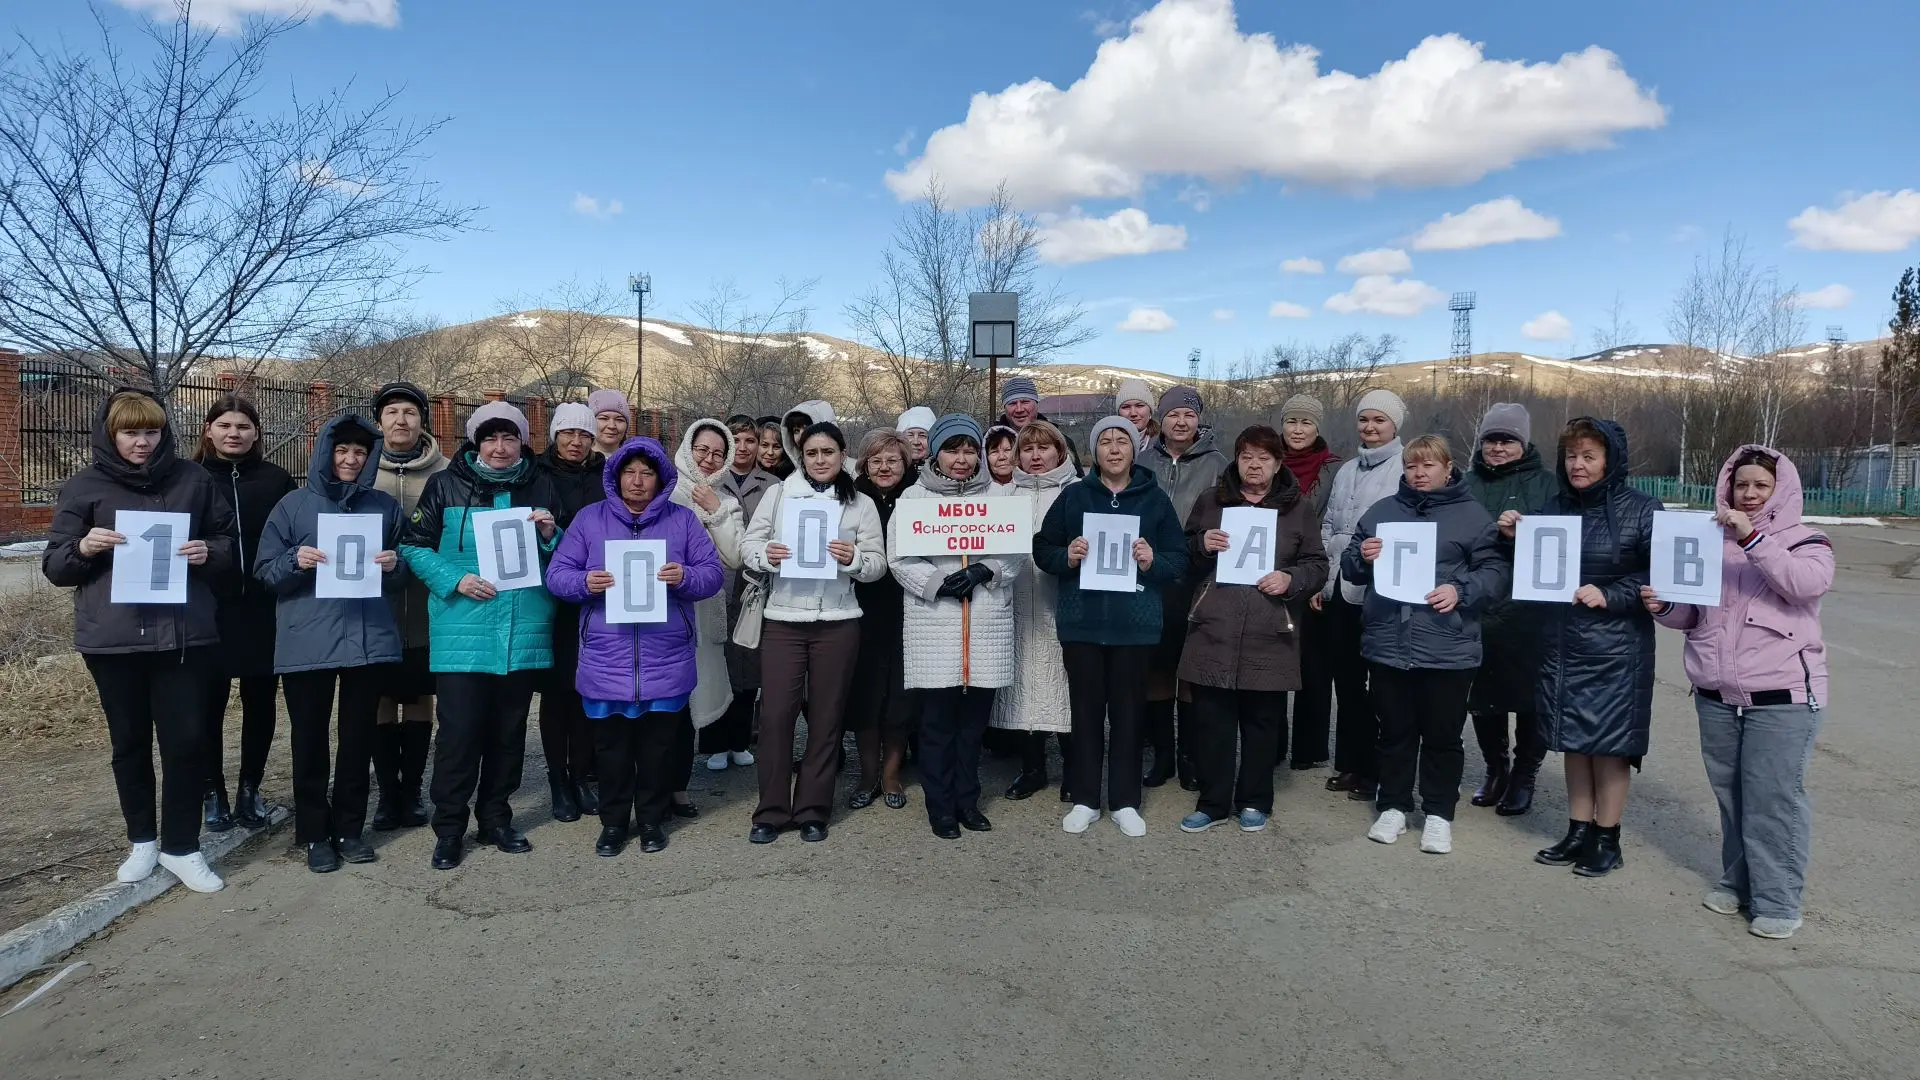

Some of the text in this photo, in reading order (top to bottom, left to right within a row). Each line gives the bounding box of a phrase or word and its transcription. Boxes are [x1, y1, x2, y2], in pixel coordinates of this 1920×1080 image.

[938, 503, 987, 517] МБОУ
[140, 524, 172, 590] 1
[947, 536, 985, 550] СОШ
[1096, 531, 1132, 576] Ш
[1235, 526, 1267, 570] А
[1393, 541, 1418, 586] Г
[1673, 536, 1704, 586] В
